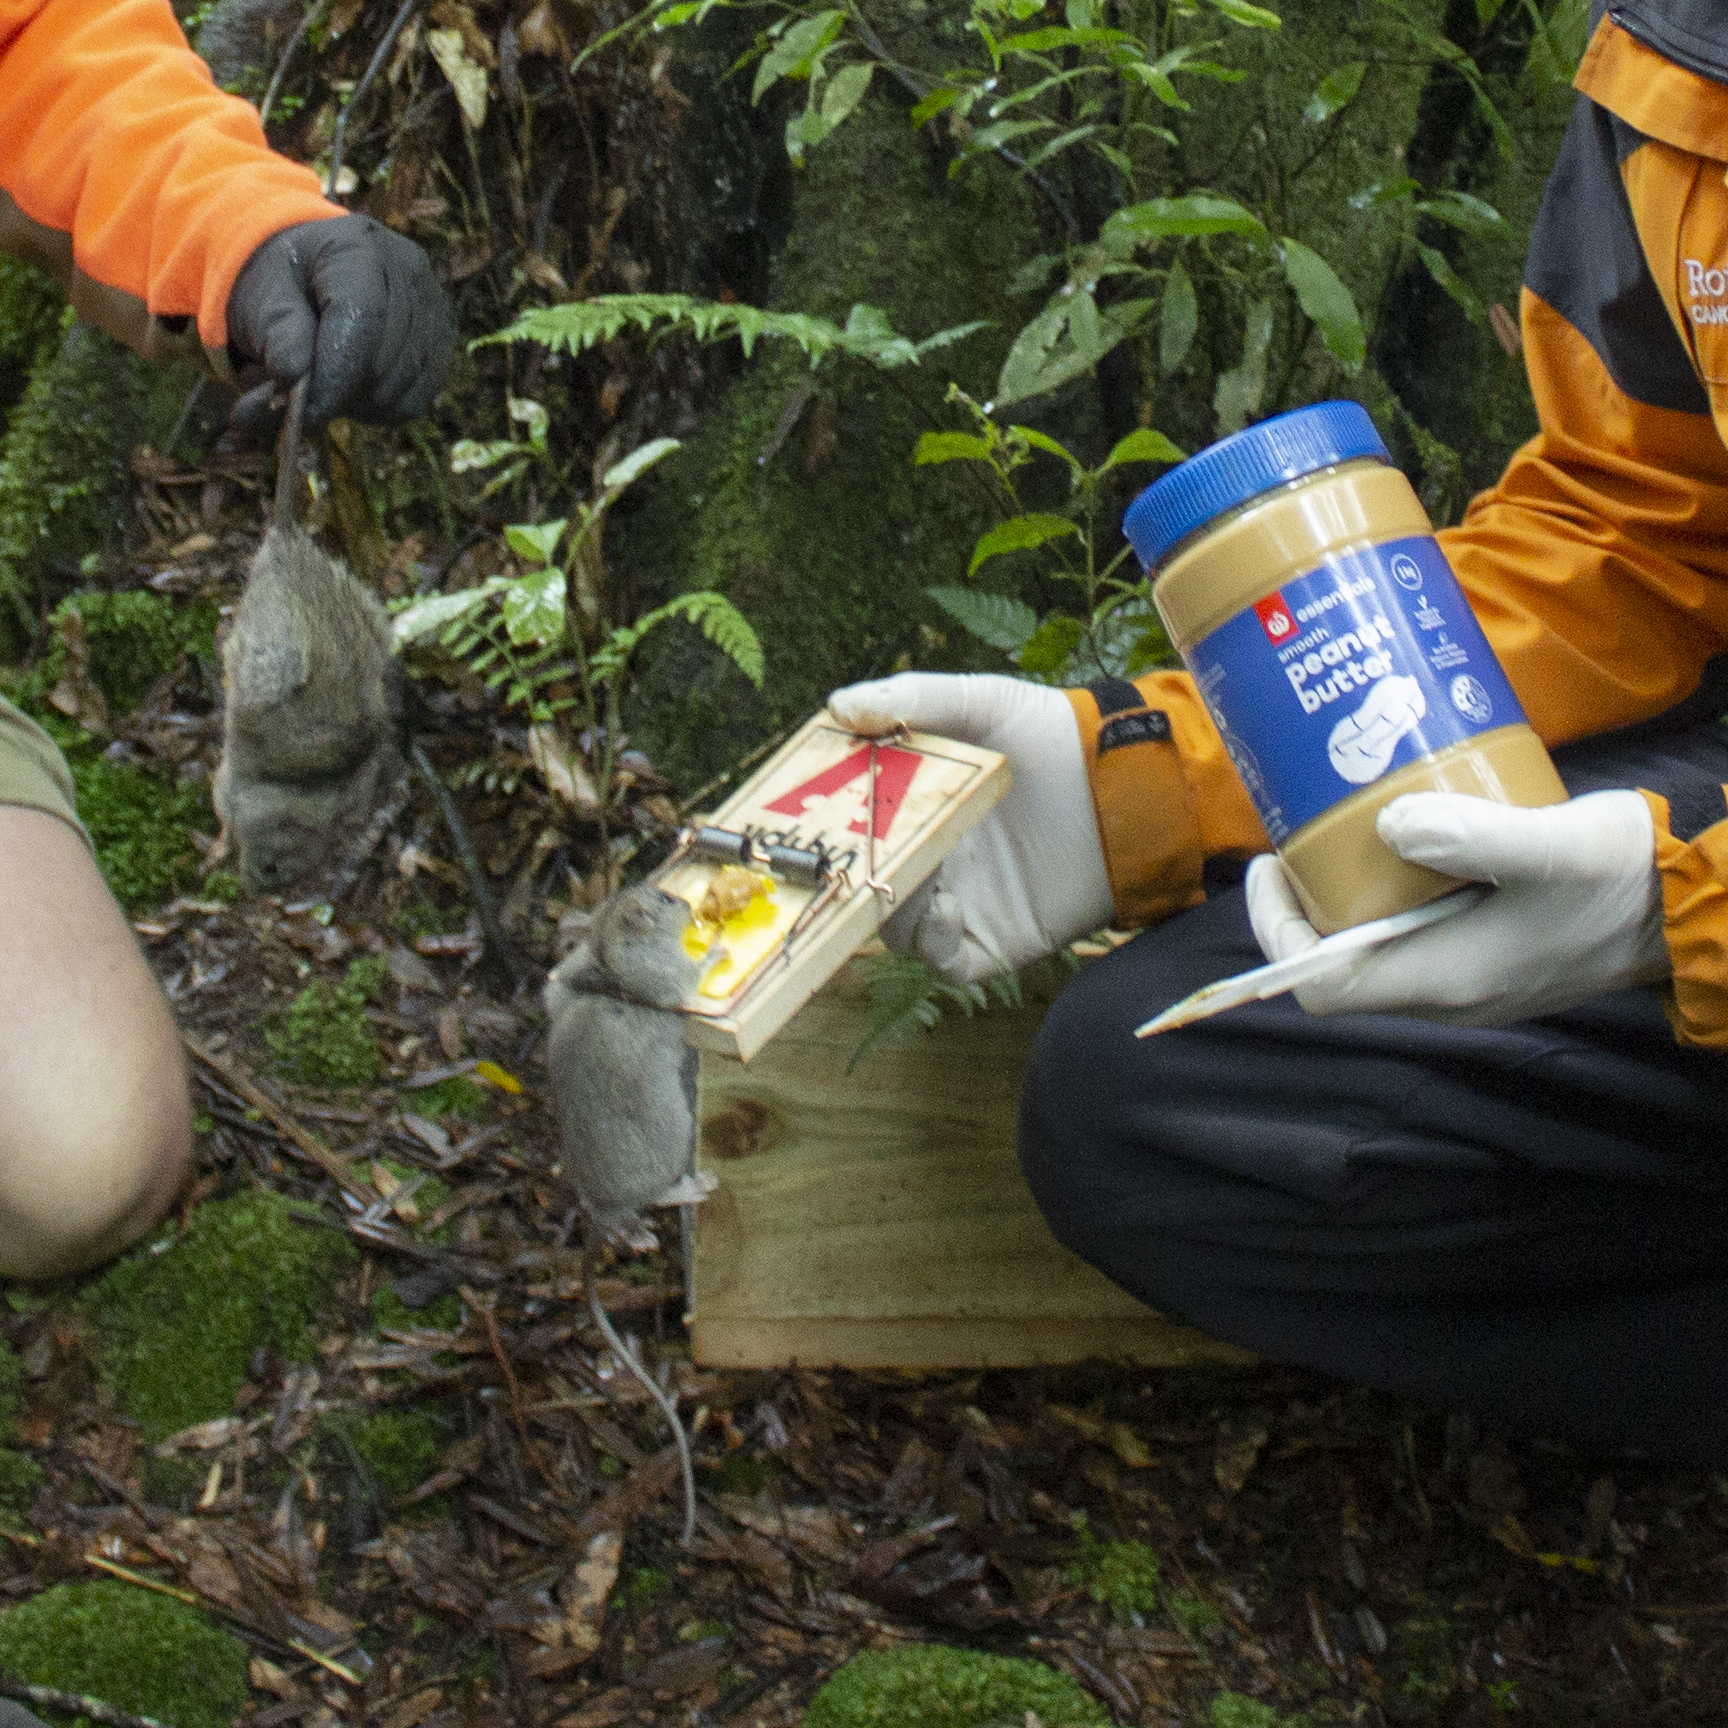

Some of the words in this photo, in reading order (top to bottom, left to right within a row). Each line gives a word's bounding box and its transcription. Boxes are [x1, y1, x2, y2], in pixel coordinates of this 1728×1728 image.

[1296, 576, 1376, 623] essenals
[1277, 627, 1330, 664] smooth
[1285, 615, 1396, 691] peanut
[1295, 649, 1394, 715] butter
